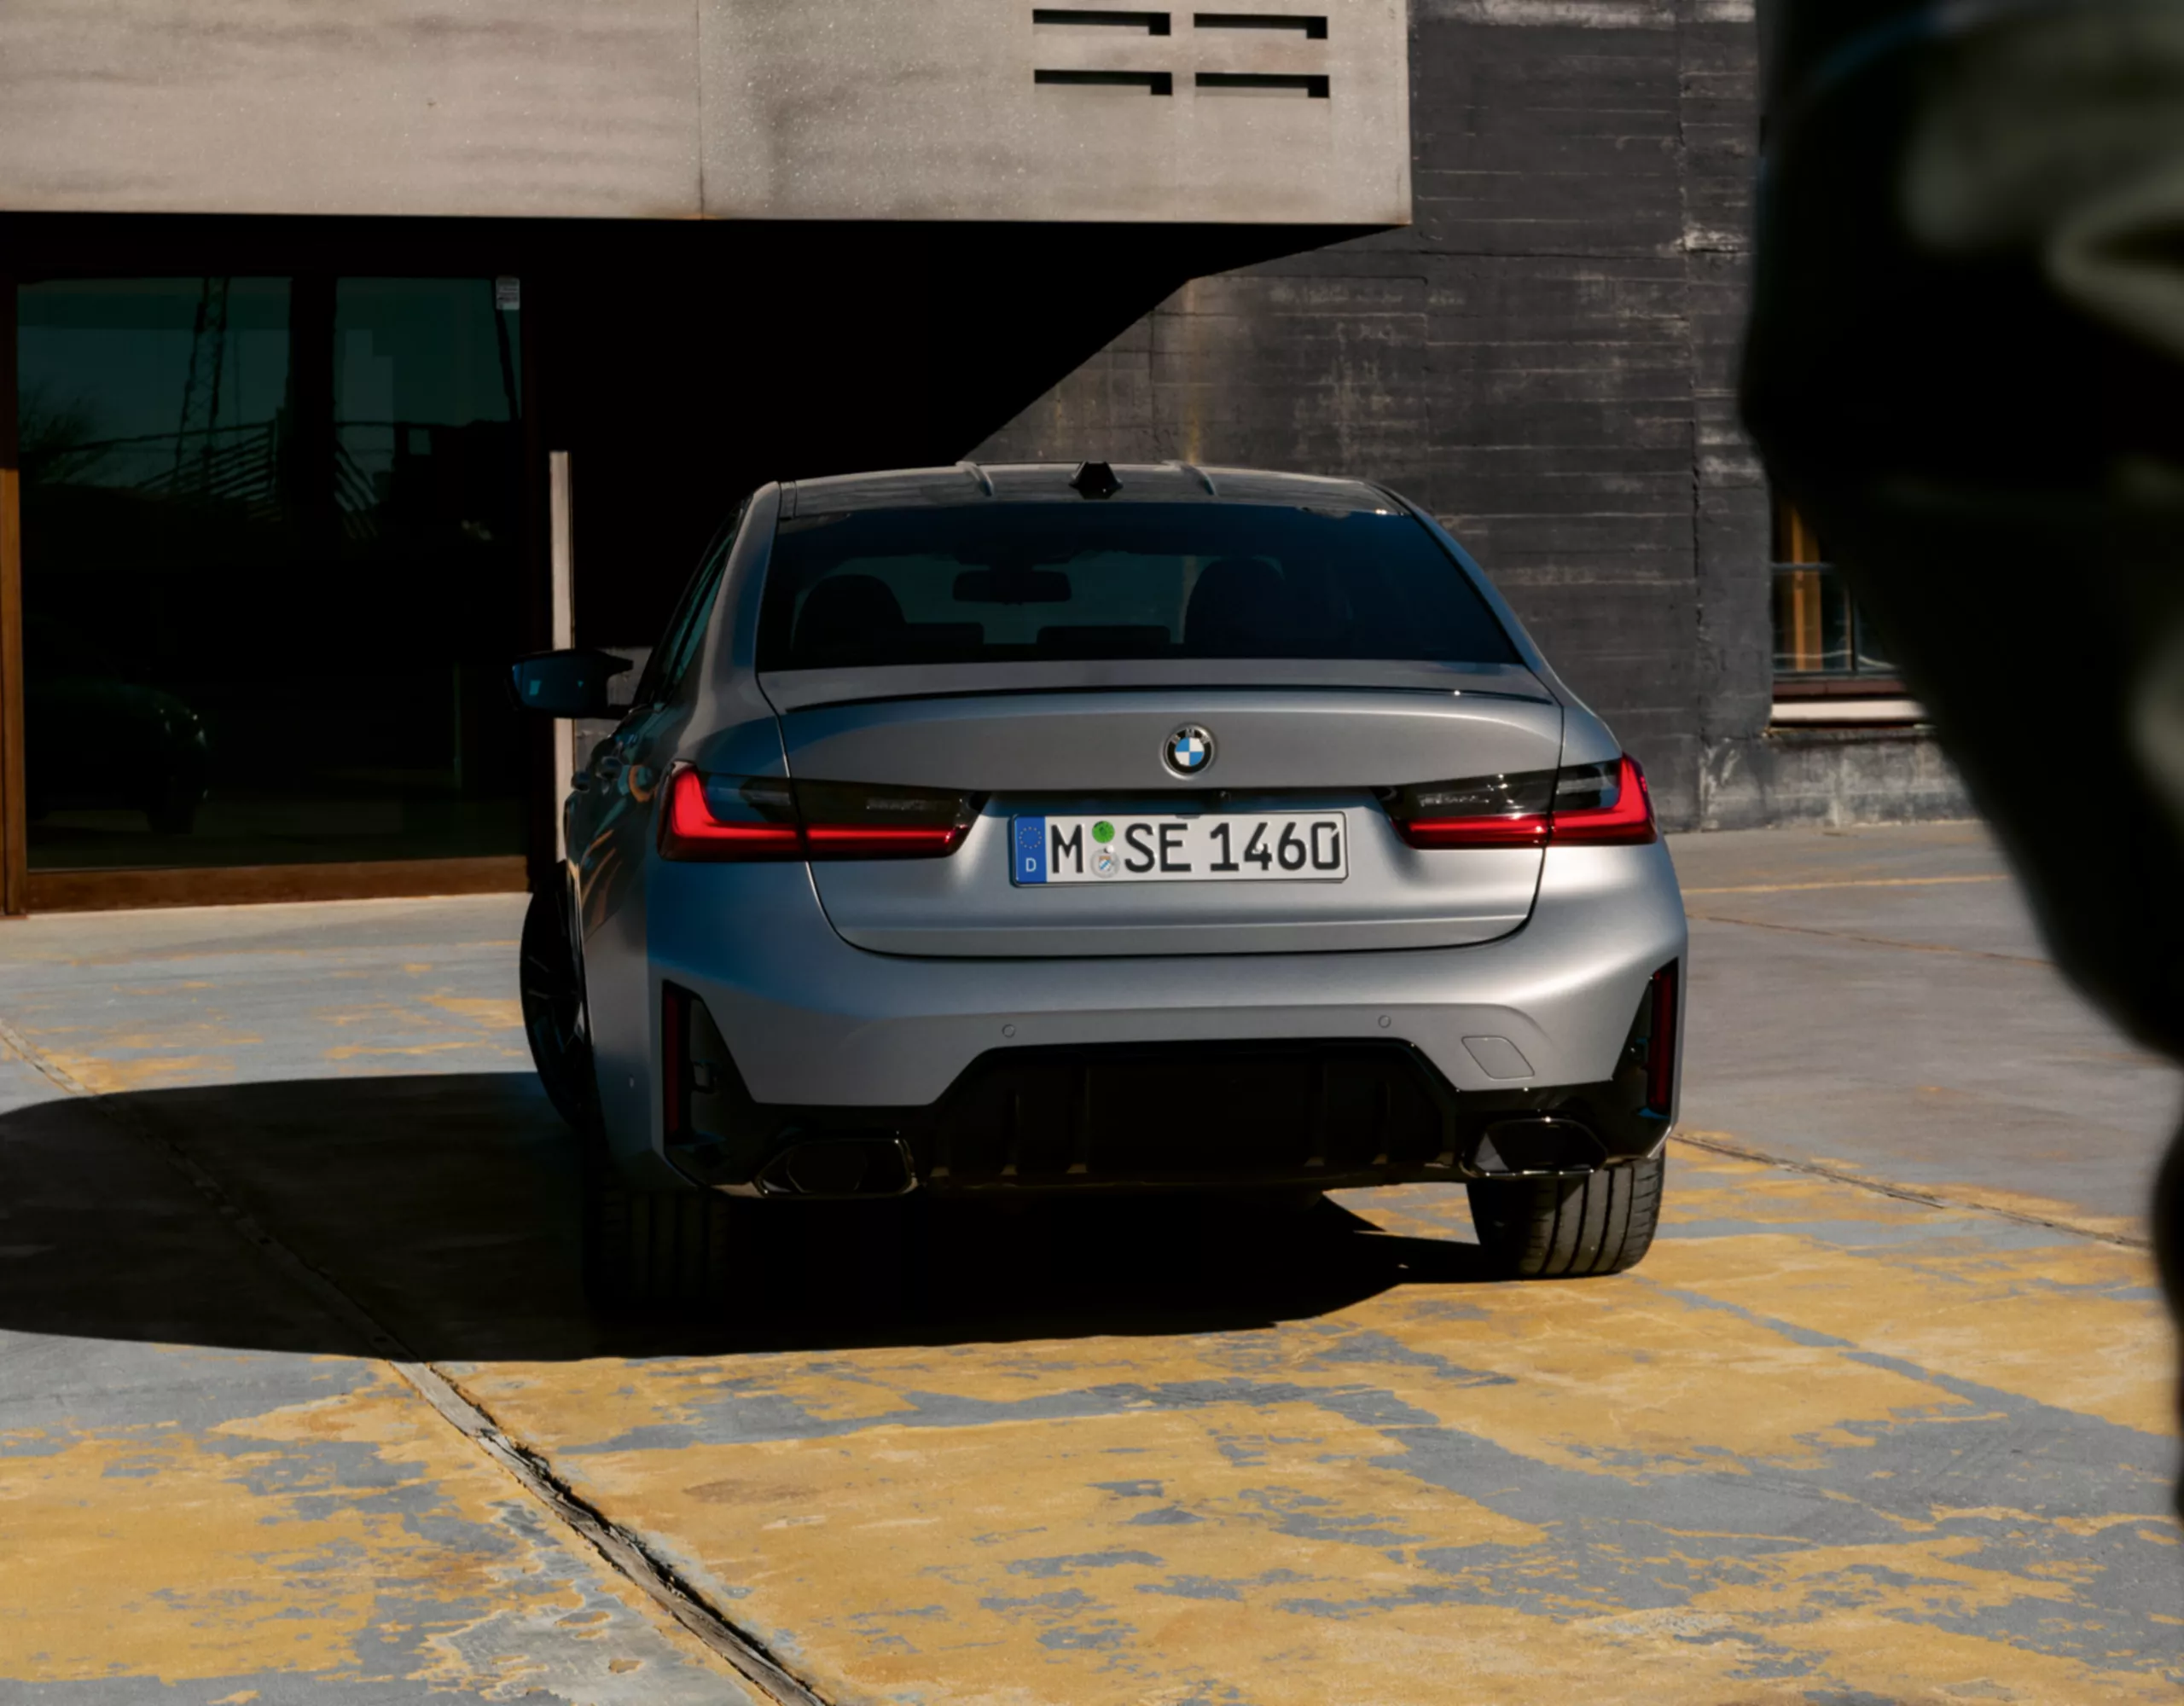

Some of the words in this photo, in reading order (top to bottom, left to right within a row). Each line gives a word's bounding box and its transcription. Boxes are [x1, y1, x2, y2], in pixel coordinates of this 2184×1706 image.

[1050, 824, 1083, 873] M
[1124, 823, 1192, 873] SE
[1210, 821, 1341, 872] 1460
[1025, 857, 1037, 872] D
